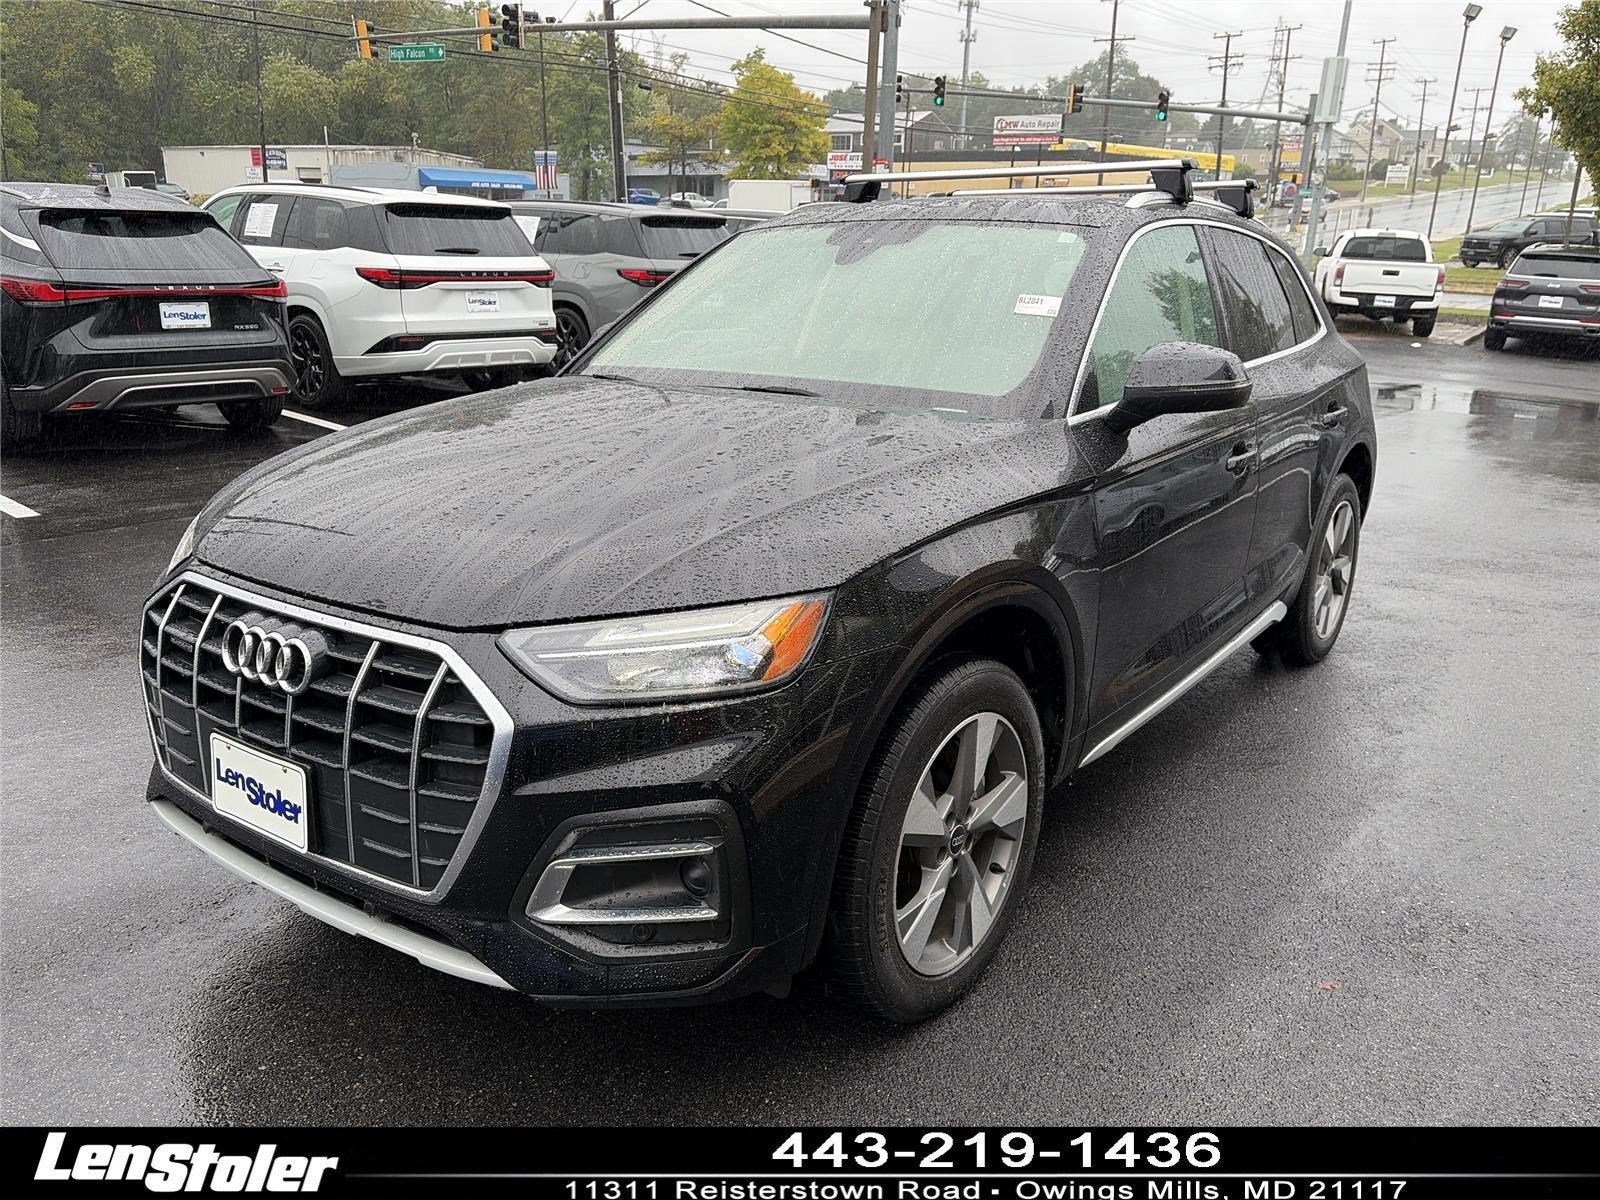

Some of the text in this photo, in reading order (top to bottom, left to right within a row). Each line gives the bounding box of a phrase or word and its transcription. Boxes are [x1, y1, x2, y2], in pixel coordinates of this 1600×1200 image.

[390, 48, 405, 60] High
[406, 48, 426, 58] Falcon
[1020, 120, 1036, 128] Auto
[1038, 119, 1060, 129] Repair
